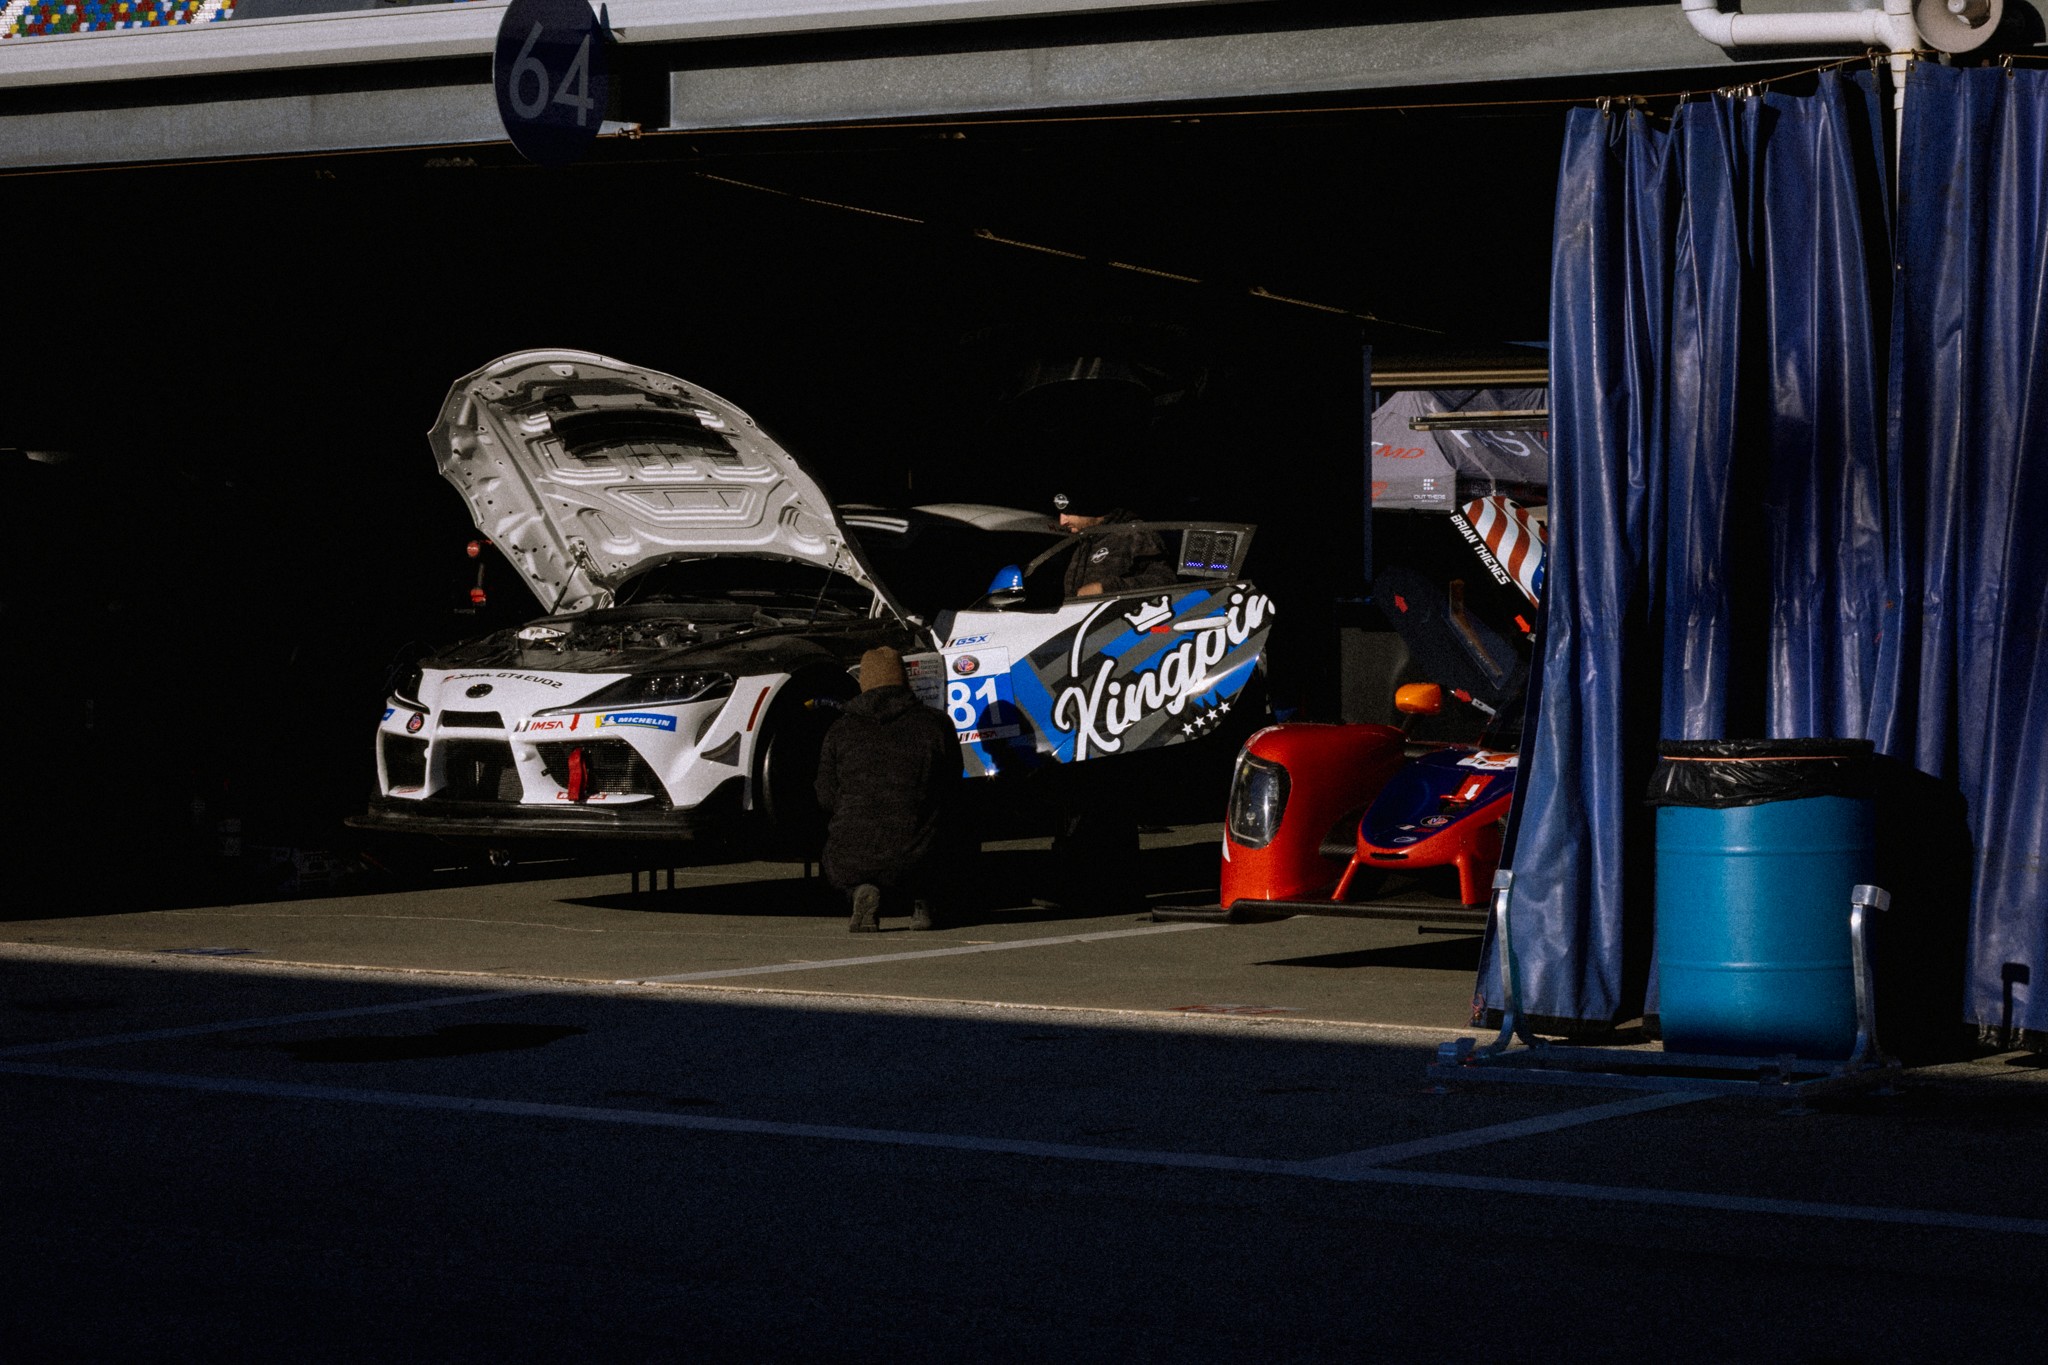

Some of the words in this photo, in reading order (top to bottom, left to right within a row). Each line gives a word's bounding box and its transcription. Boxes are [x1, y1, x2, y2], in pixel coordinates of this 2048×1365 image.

[509, 20, 594, 127] 64
[1450, 513, 1480, 544] BRIAN
[1473, 543, 1511, 585] THIENES
[955, 634, 988, 646] GSX
[1054, 593, 1275, 762] Kingpin
[946, 677, 1003, 730] 81
[530, 720, 564, 731] IMSA
[617, 716, 671, 727] MICHELIN
[970, 731, 998, 740] IMSA
